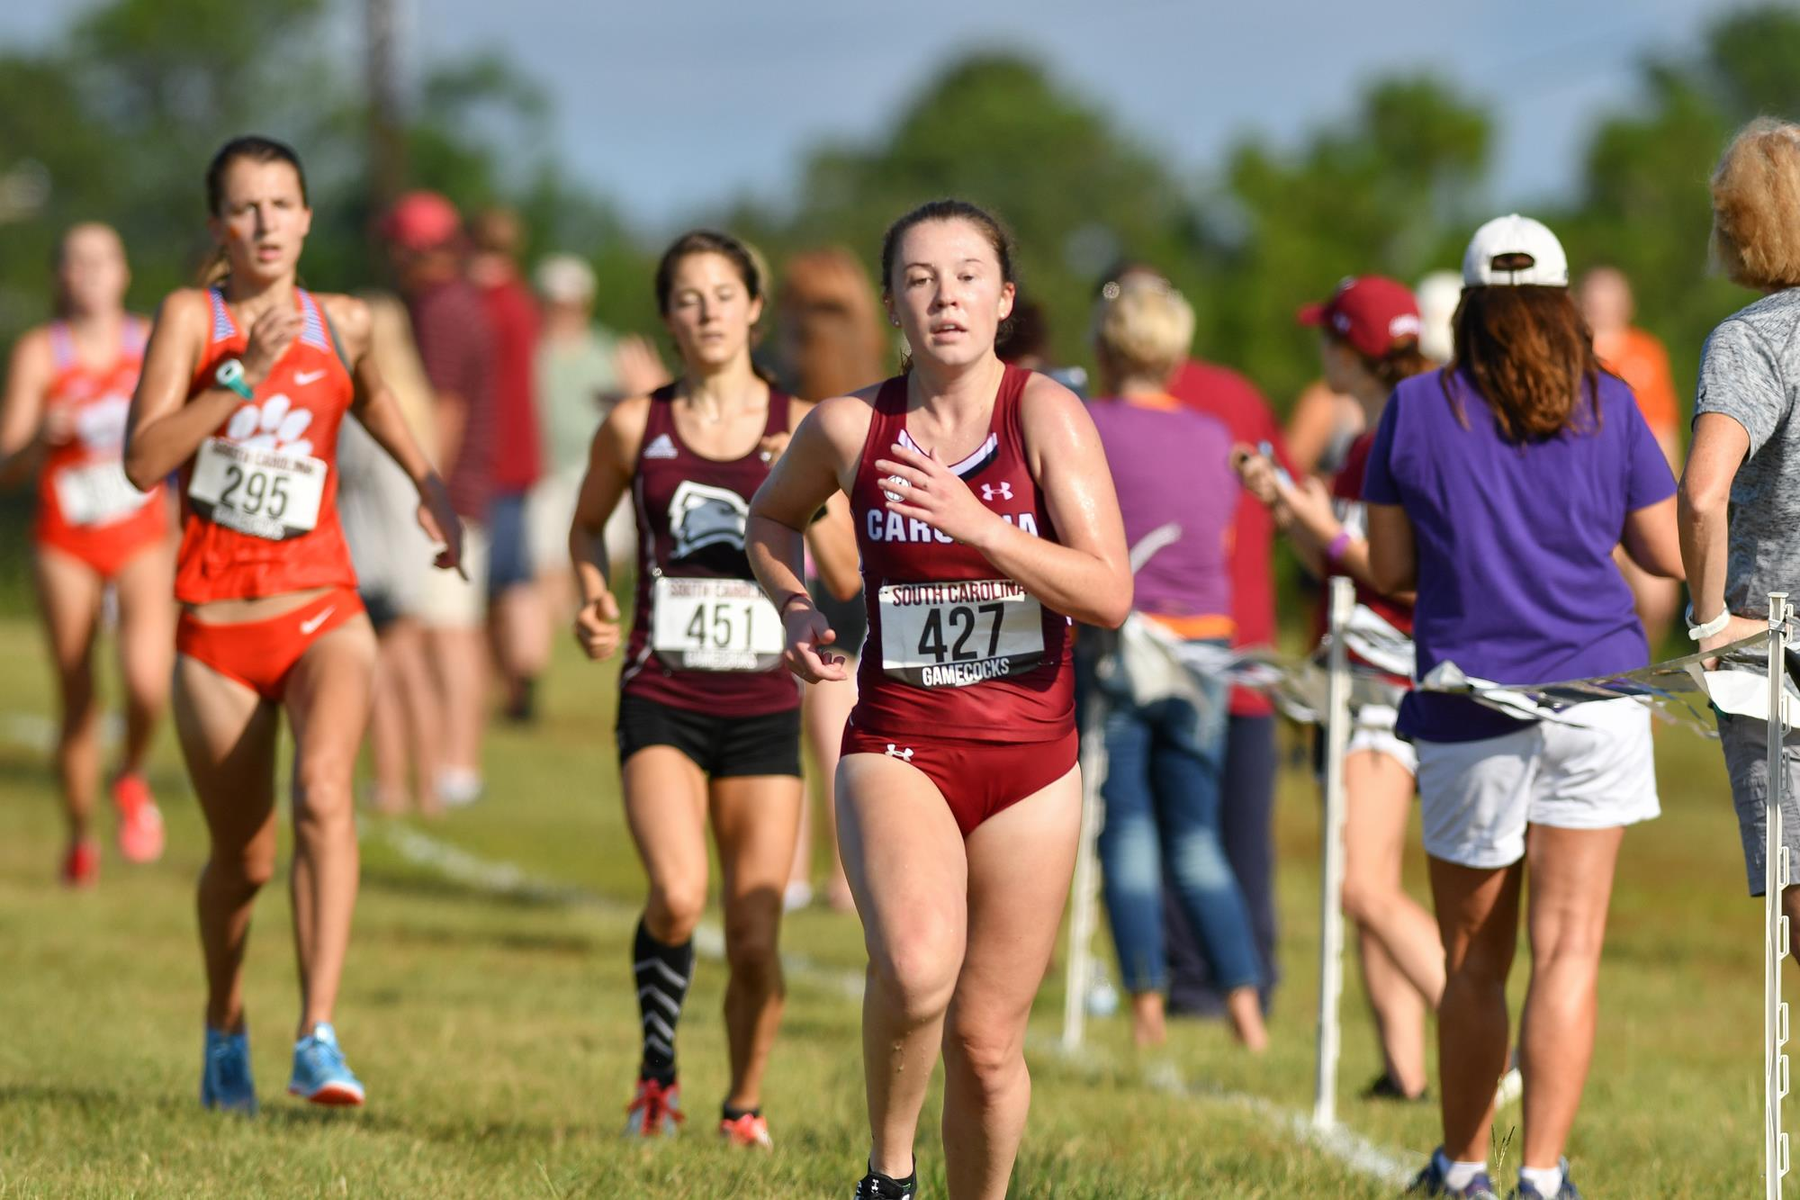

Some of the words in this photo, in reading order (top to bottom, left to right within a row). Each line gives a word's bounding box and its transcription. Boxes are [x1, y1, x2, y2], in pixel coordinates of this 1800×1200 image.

[220, 464, 289, 520] 295
[893, 585, 943, 606] SOUTH
[948, 580, 1027, 603] CAROLINA
[685, 603, 752, 651] 451
[918, 603, 1005, 663] 427
[922, 658, 1010, 687] GAMECOCKS
